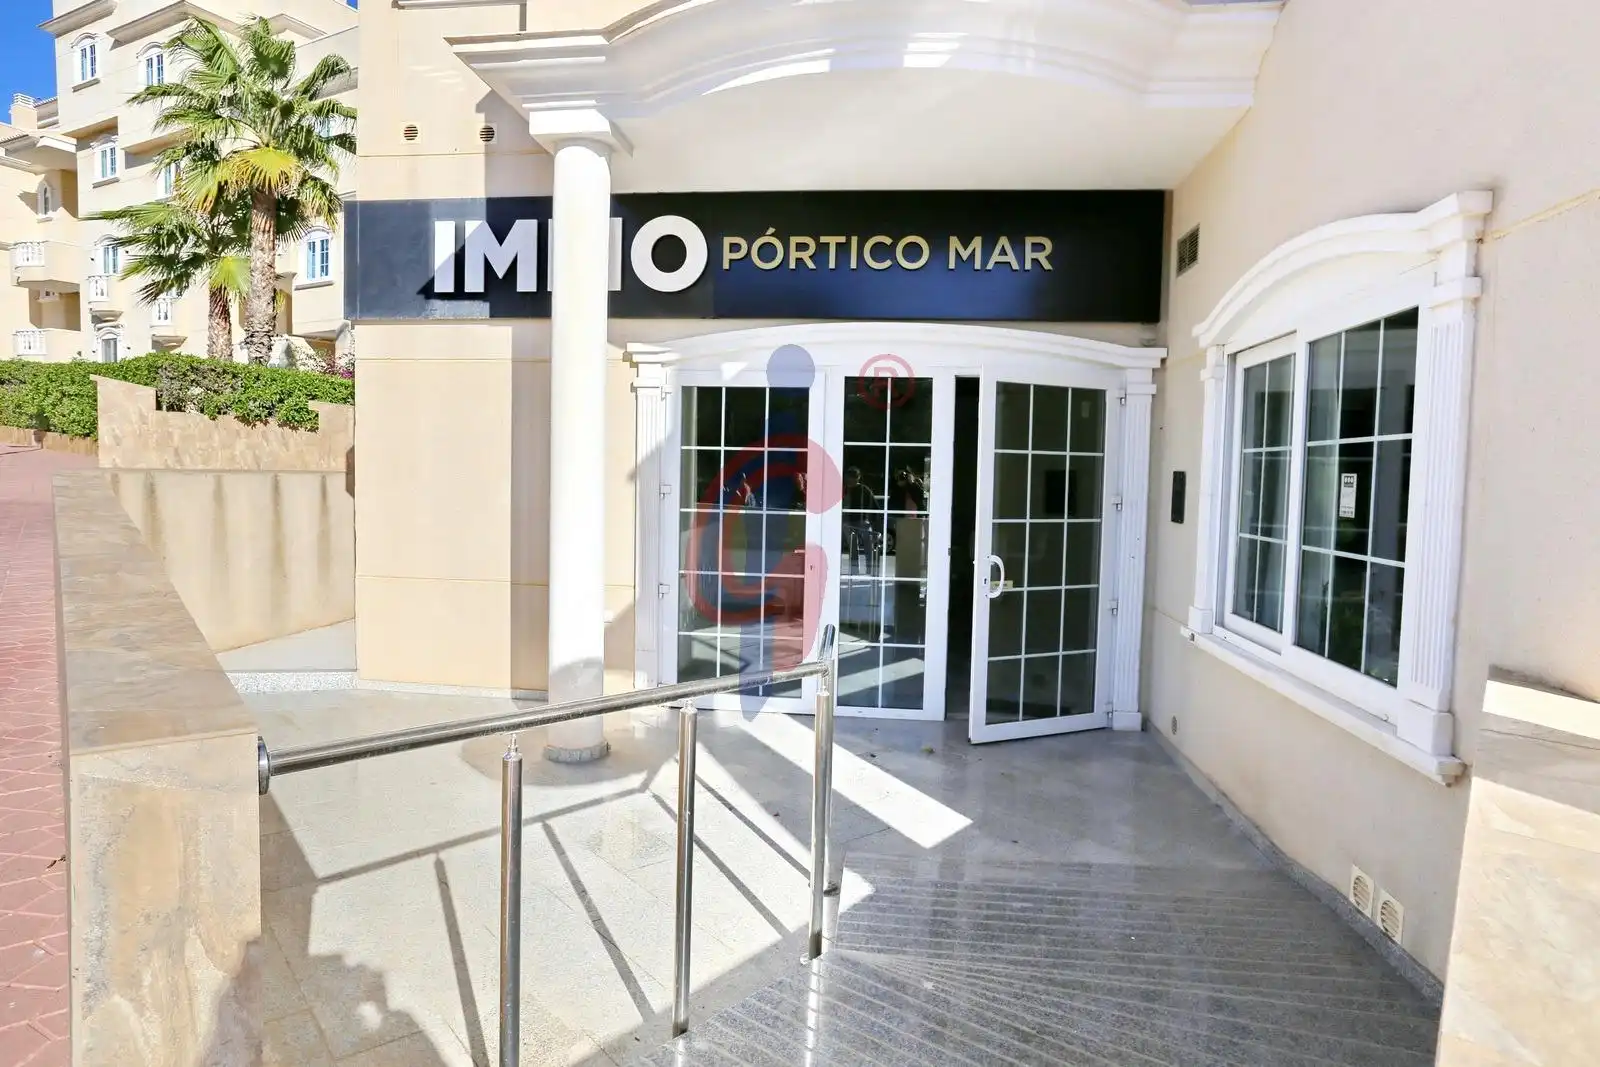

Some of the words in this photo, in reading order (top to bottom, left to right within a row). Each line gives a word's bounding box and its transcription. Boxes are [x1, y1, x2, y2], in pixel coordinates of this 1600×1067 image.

[433, 215, 708, 293] IMO
[722, 227, 930, 271] PÓRTICO
[948, 235, 1054, 271] MAR
